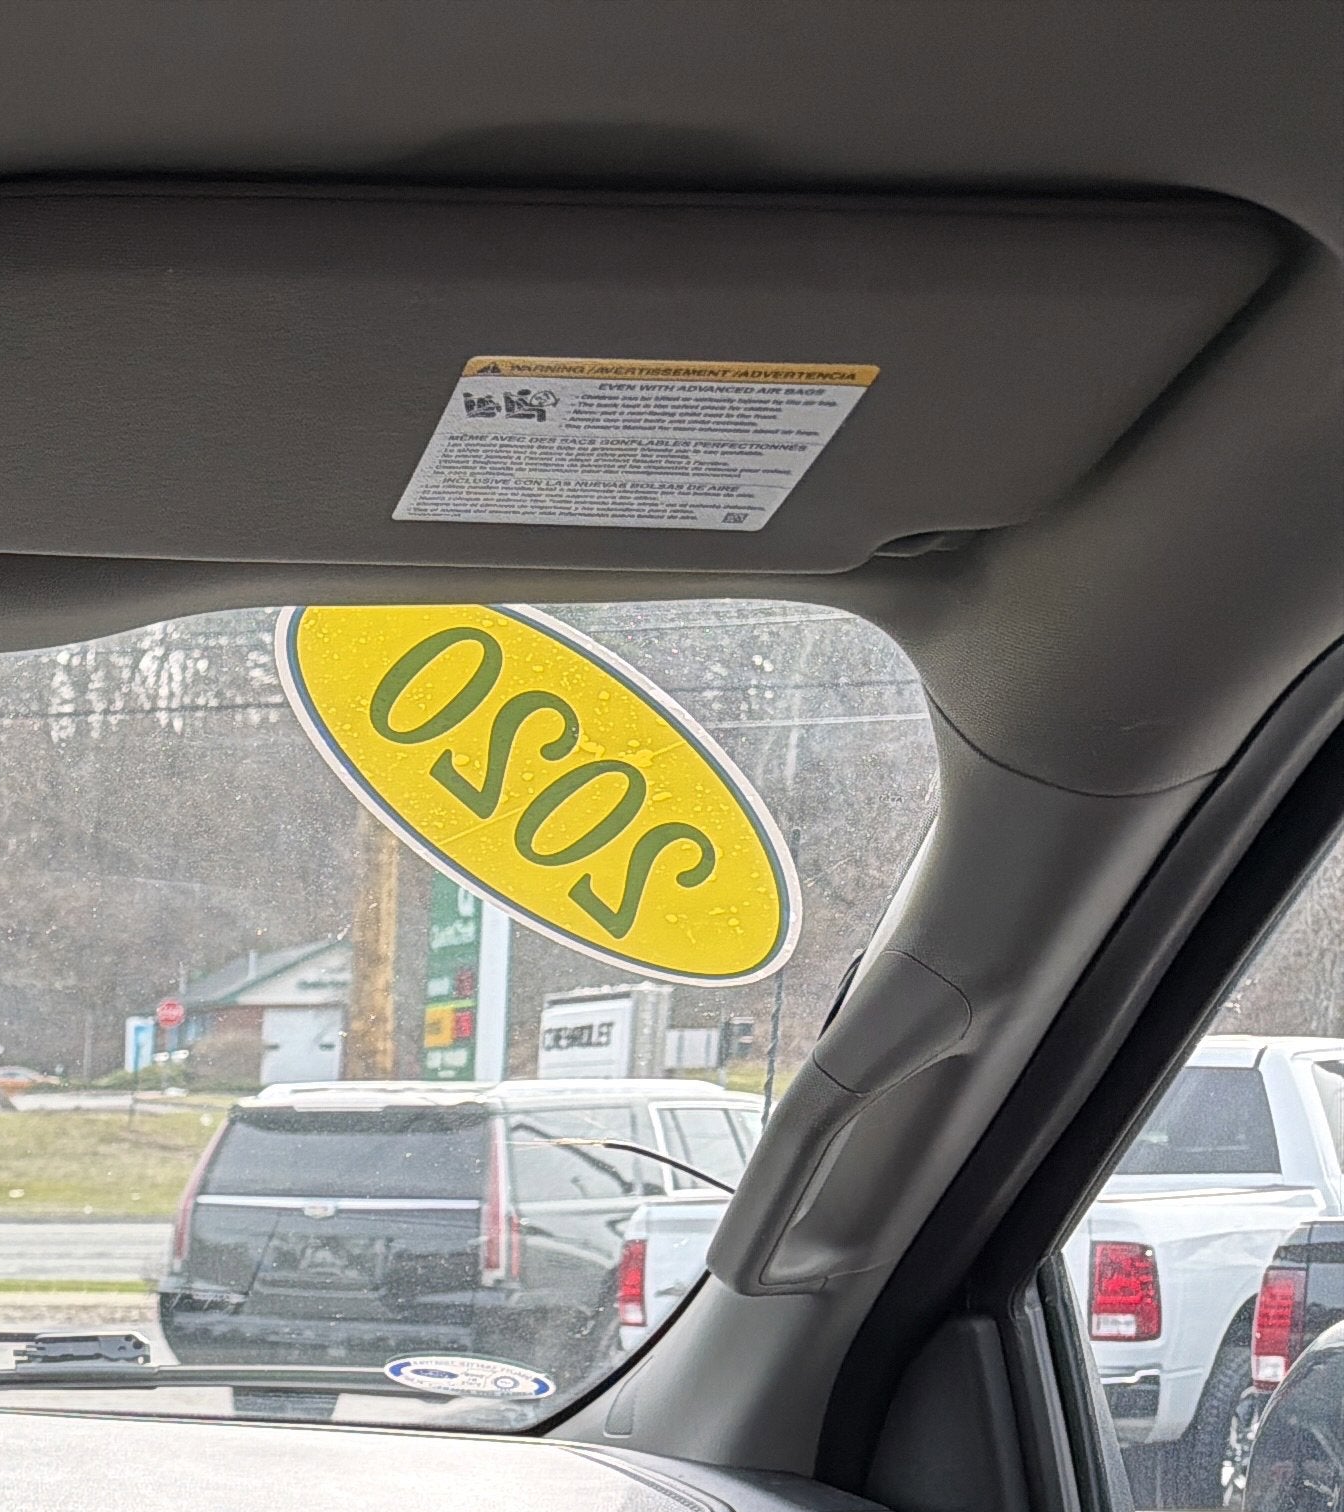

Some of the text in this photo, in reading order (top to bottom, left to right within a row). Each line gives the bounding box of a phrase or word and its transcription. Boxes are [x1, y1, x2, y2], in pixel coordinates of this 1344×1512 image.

[597, 382, 826, 396] EVEN WITH ADVANCED AIR BAGS
